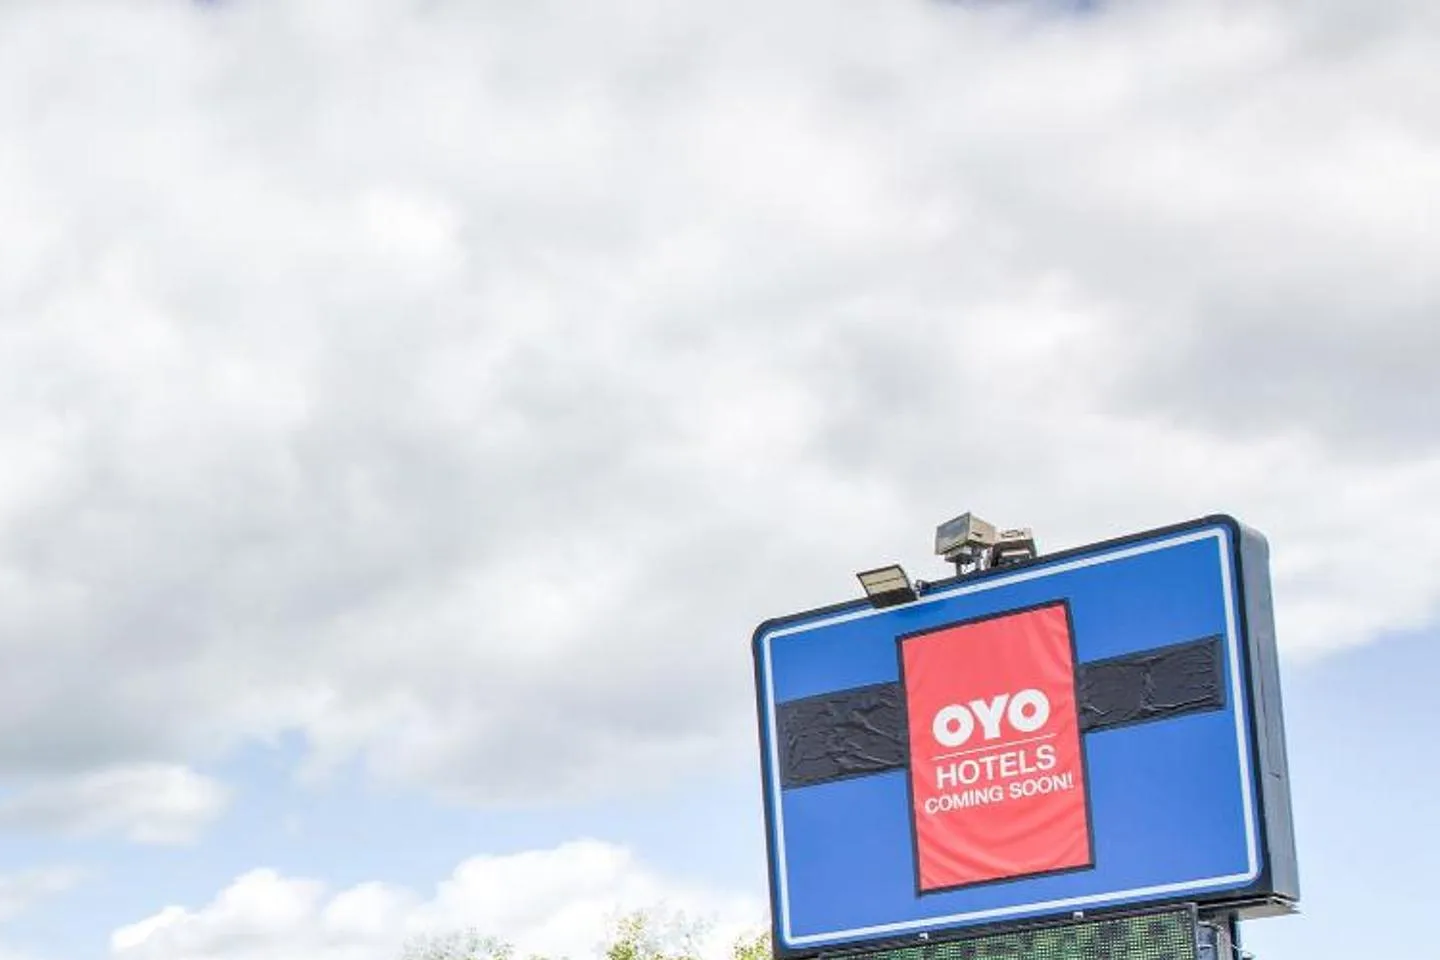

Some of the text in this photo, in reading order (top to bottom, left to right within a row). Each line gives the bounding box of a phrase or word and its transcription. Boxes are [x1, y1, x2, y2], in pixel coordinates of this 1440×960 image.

[932, 688, 1050, 747] OYO
[935, 744, 1057, 790] HOTELS
[924, 771, 1074, 814] COMING SOON!
